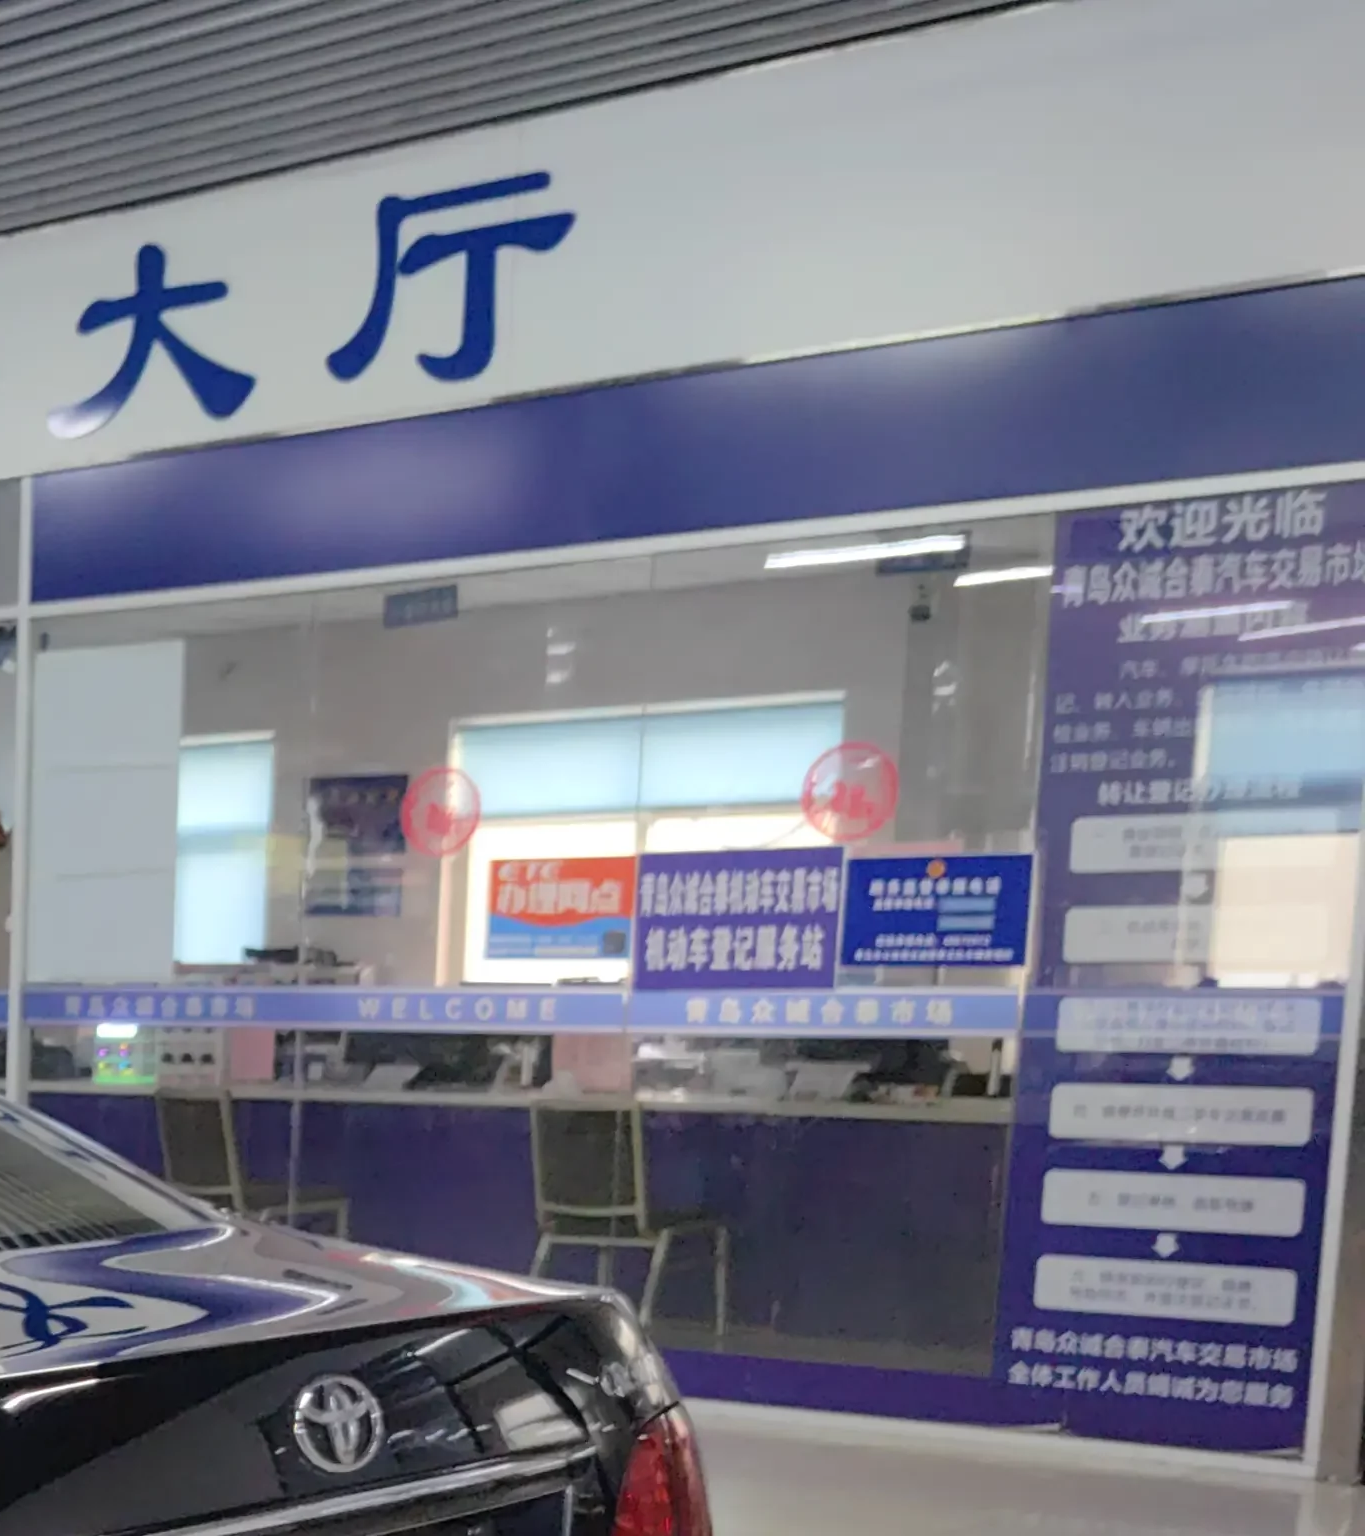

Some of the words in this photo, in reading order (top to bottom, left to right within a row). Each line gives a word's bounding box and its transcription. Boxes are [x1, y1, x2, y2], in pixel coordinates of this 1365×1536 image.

[1118, 489, 1326, 552] 欢迎光临
[358, 997, 557, 1021] WELCOME
